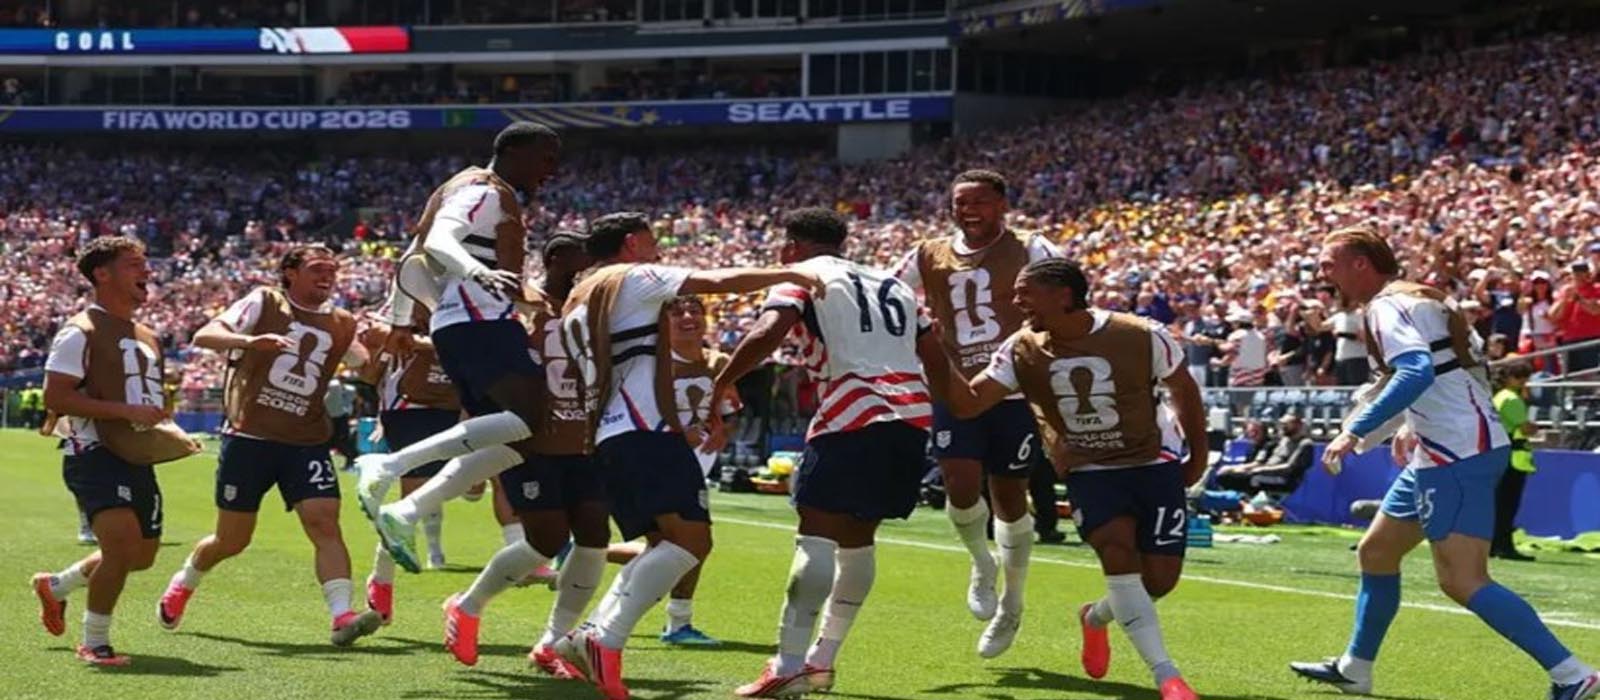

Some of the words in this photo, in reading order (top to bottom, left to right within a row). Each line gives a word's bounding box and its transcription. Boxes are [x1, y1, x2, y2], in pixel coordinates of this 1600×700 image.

[55, 32, 134, 50] GOAL
[103, 111, 160, 129] FIFA
[163, 111, 260, 129] WORLD
[263, 111, 317, 129] CUP
[320, 110, 411, 129] 2026
[728, 100, 911, 122] SEATTLE
[846, 271, 907, 337] 16
[282, 374, 305, 389] FIFA
[256, 393, 309, 417] 2026
[1075, 415, 1103, 425] FIFA
[1017, 433, 1034, 460] 6
[1100, 431, 1123, 441] CUP
[309, 460, 337, 483] 23
[1154, 506, 1186, 537] 12
